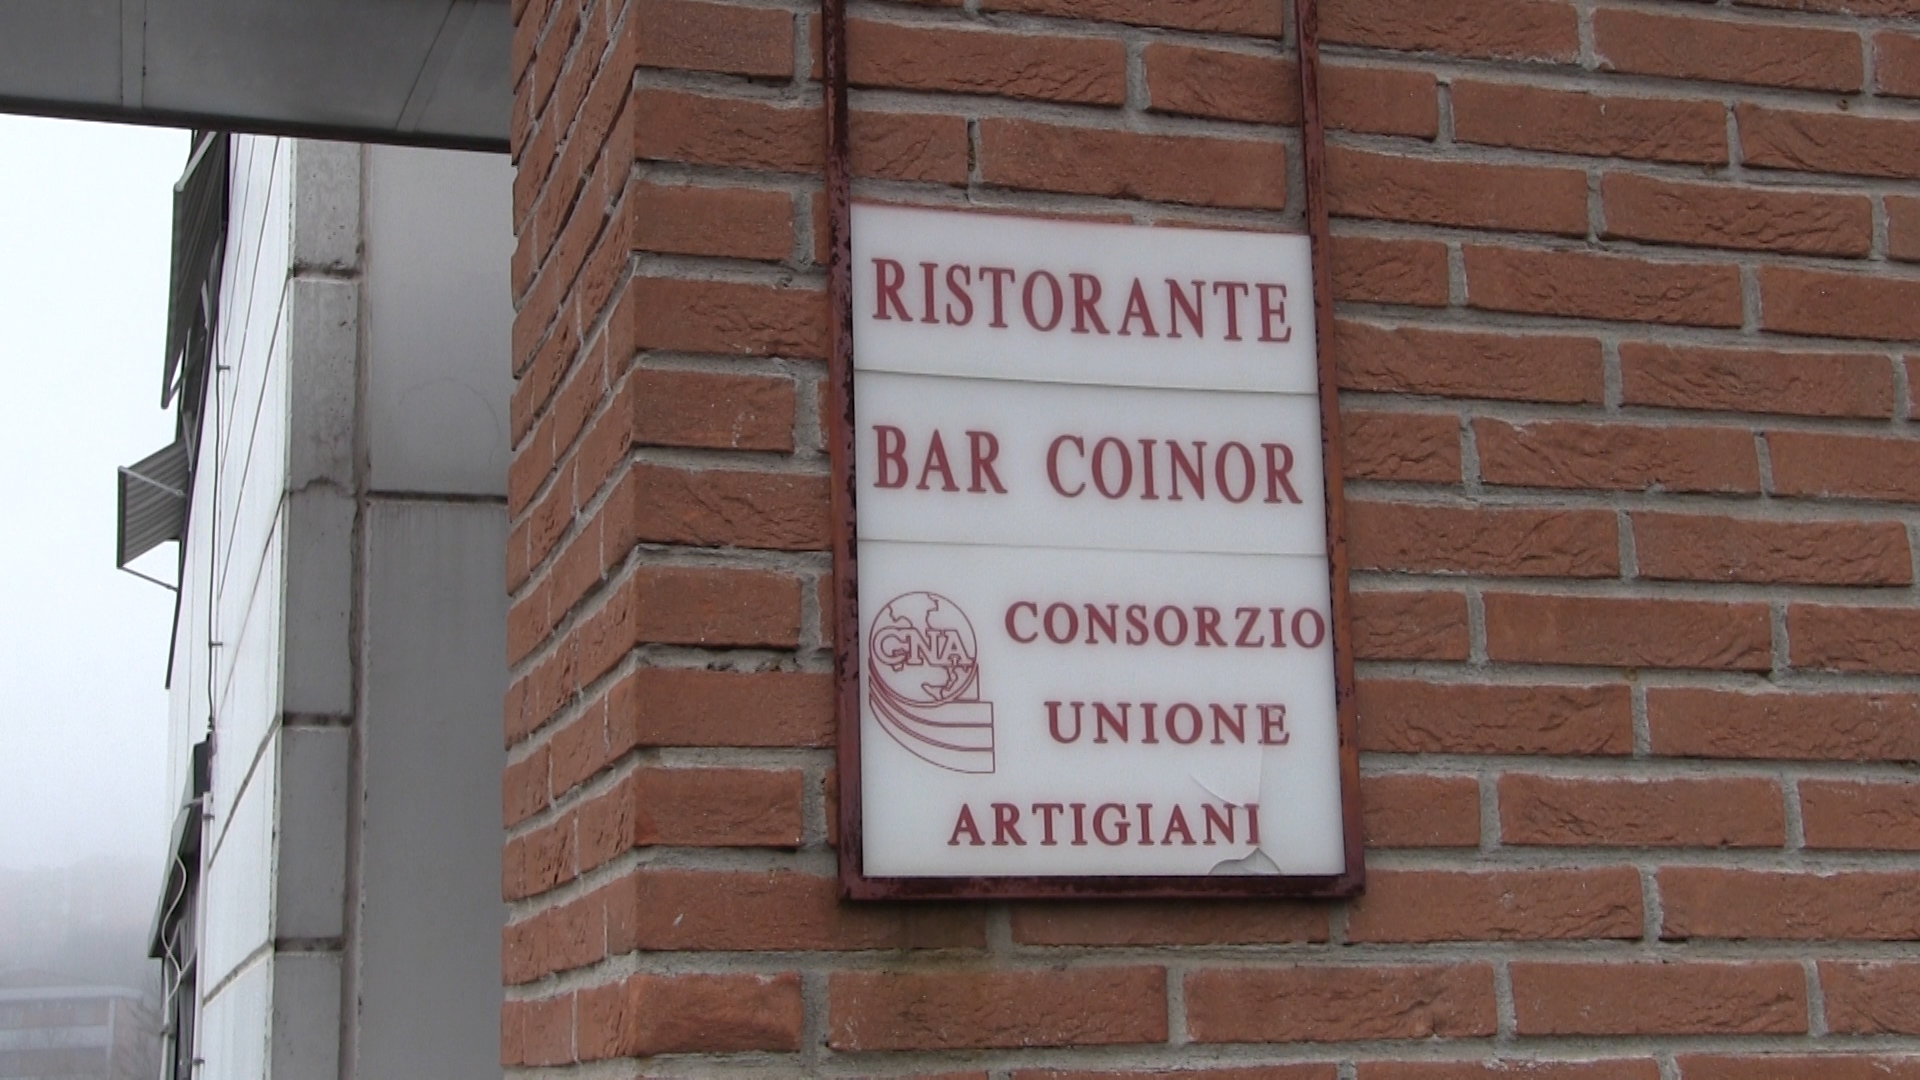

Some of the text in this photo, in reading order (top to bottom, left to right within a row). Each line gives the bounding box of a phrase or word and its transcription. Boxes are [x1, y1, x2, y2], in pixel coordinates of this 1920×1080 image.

[870, 256, 1292, 344] RISTORANTE
[871, 423, 1303, 505] BAR COINOR
[1004, 601, 1326, 649] CONSORZIO
[1043, 701, 1291, 746] UNIONE
[947, 802, 1261, 848] ARTIGIANI
